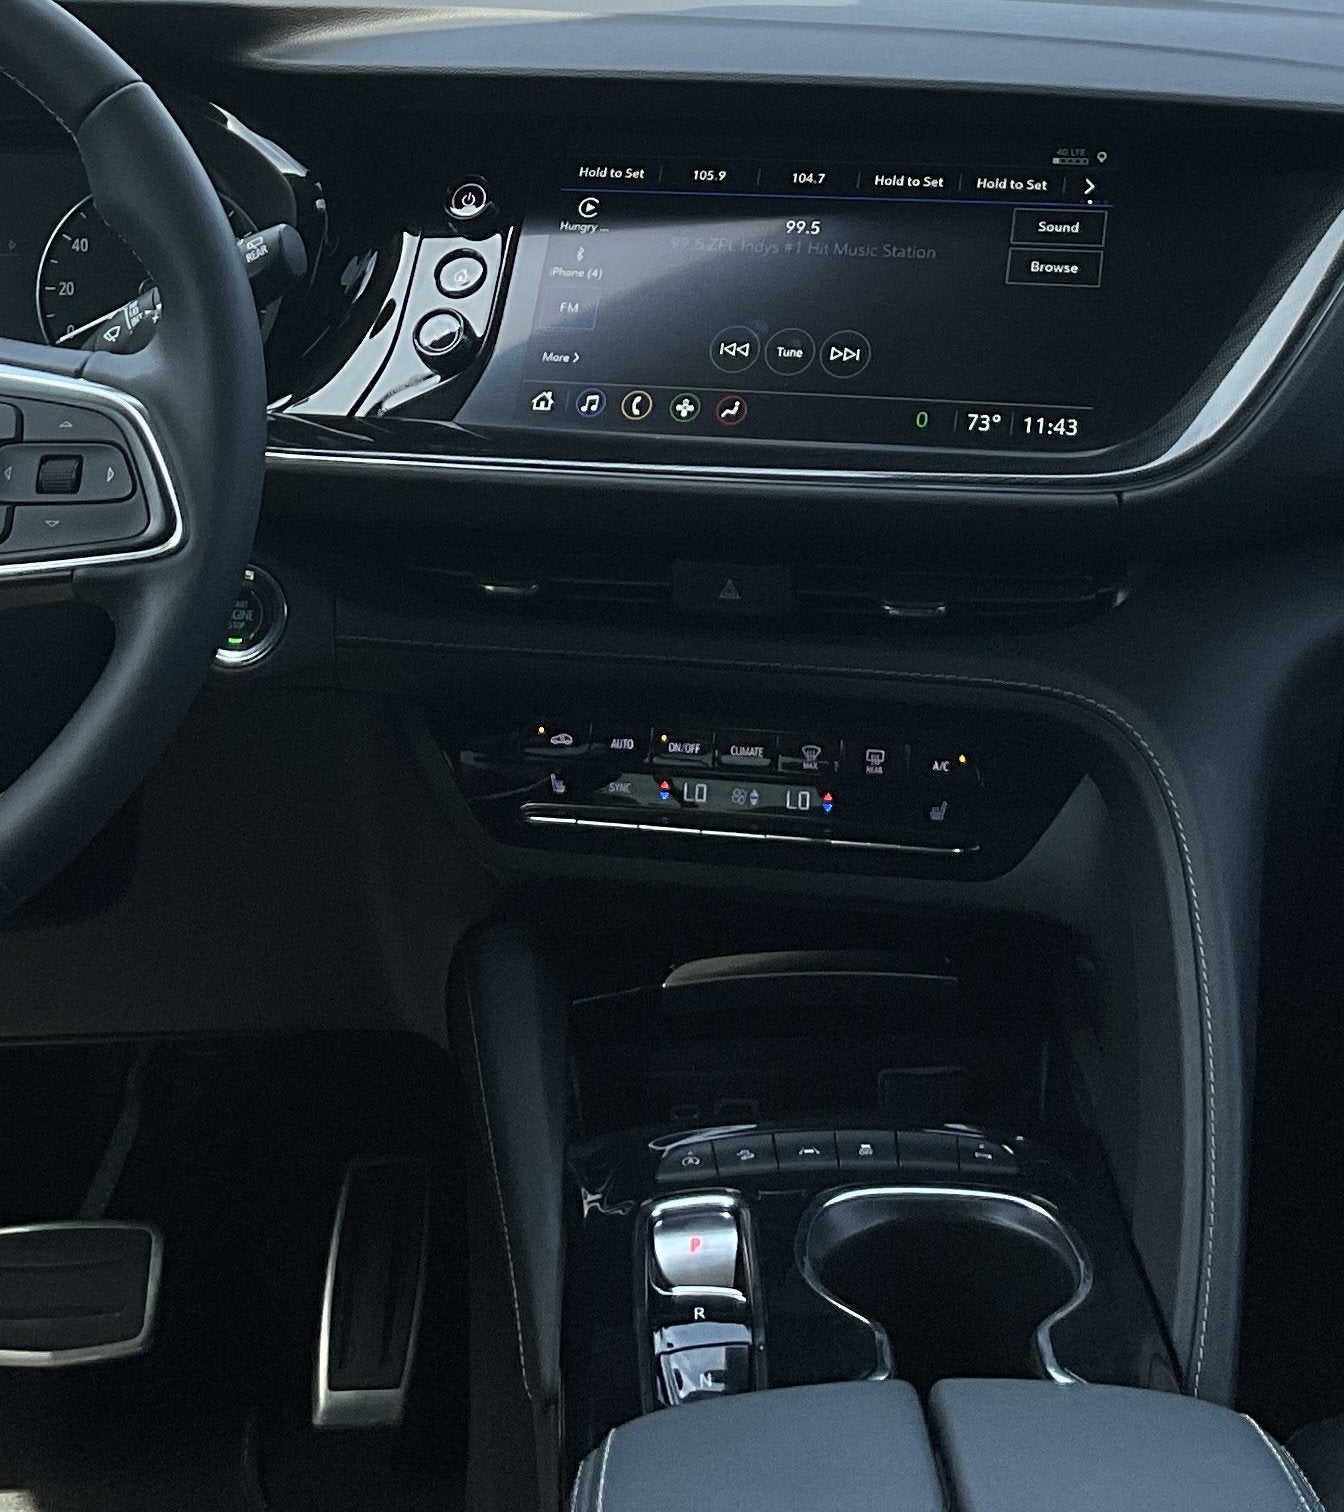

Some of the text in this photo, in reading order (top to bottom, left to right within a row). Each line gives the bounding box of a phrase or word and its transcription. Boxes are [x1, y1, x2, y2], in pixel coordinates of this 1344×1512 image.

[579, 167, 645, 179] Hold to Set
[693, 170, 727, 181] 105.9
[792, 173, 826, 184] 104.7
[875, 175, 944, 188] Hold to Set
[976, 178, 1048, 191] Hold to Set
[560, 221, 598, 234] Hungry
[786, 221, 821, 235] 99.5
[1038, 221, 1080, 233] Sound
[71, 238, 89, 252] 40
[832, 243, 877, 259] Music
[880, 244, 937, 259] Station
[246, 245, 269, 263] REAR
[1030, 261, 1079, 274] Browse
[58, 282, 75, 296] 20
[559, 302, 579, 313] FM
[542, 352, 571, 363] More
[777, 347, 804, 359] Tune
[968, 413, 1002, 431] 73°
[1024, 417, 1078, 436] 11:43
[611, 738, 635, 750] AUTO
[668, 742, 701, 754] ON/OFF
[932, 761, 950, 772] A/C
[608, 782, 632, 794] SYNC
[684, 783, 707, 803] LO
[786, 791, 810, 810] LO
[689, 1238, 701, 1252] P
[694, 1307, 705, 1320] R
[699, 1372, 712, 1388] N
